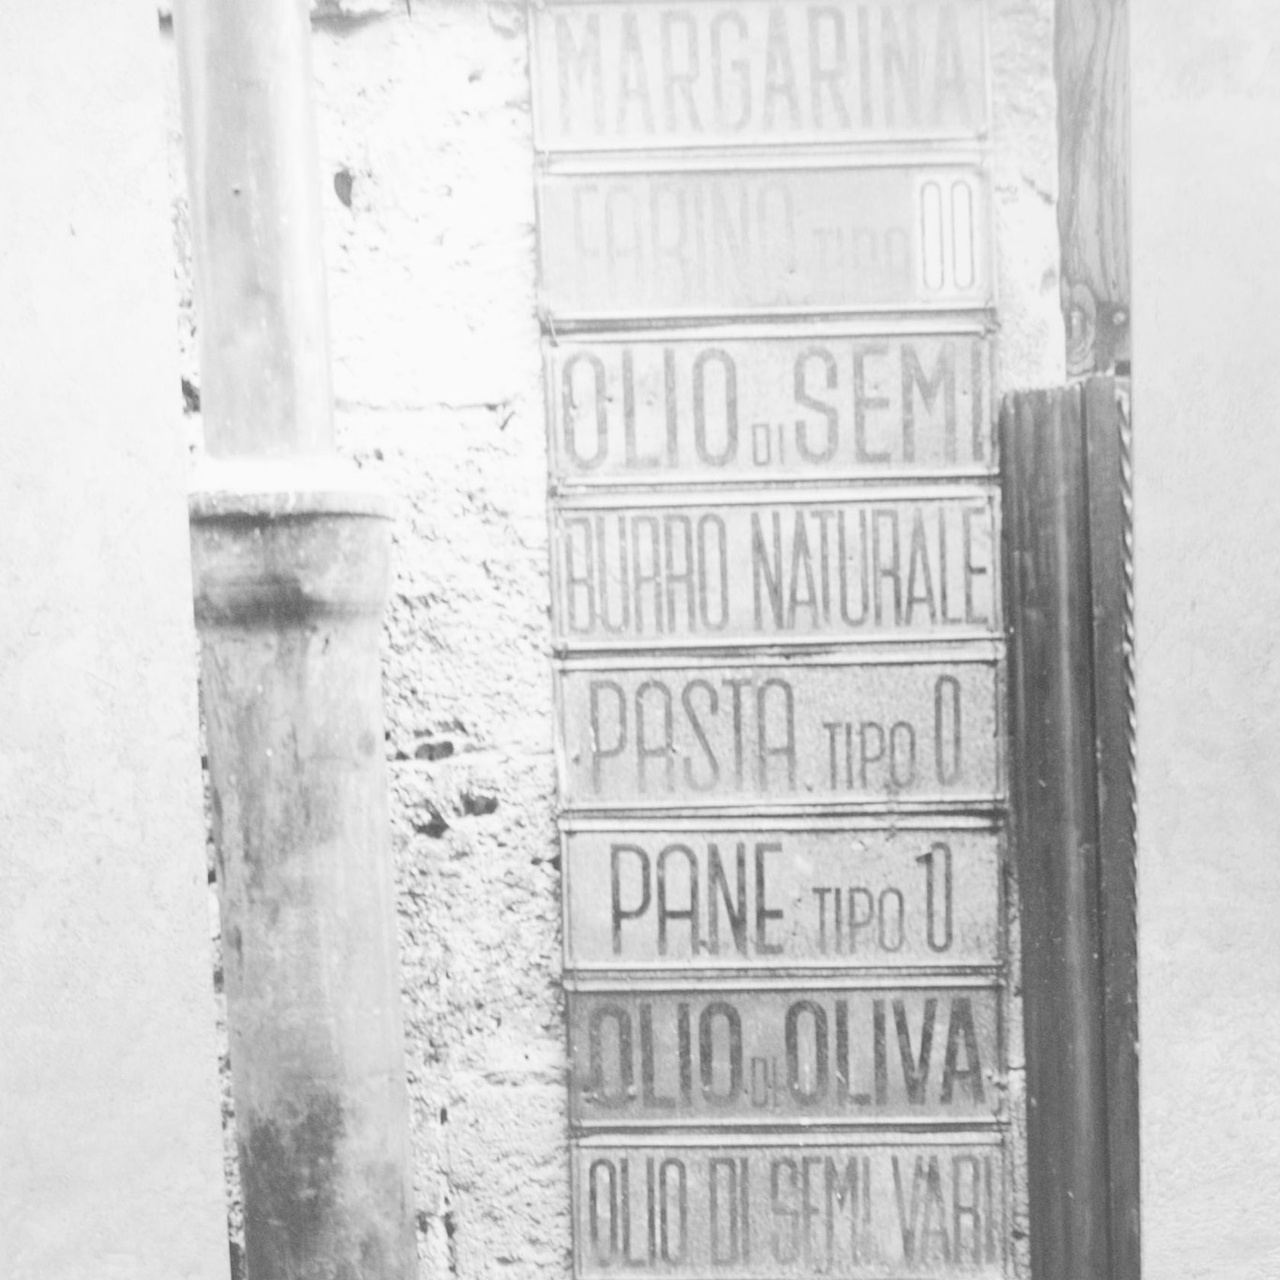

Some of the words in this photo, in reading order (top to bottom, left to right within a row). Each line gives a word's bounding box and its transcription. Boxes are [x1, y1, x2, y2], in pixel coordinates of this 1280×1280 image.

[556, 8, 968, 134] MARGARINA
[561, 345, 738, 470] OLIO
[751, 423, 784, 466] DI
[793, 342, 985, 465] SEMI
[564, 513, 729, 635] BURRO
[750, 508, 988, 631] NATURALE
[590, 677, 796, 793] PASTA
[823, 722, 916, 789] TIPO
[610, 843, 784, 956] PANE
[812, 887, 904, 954] TIPO
[588, 1003, 742, 1108] OLIO
[785, 999, 985, 1105] OLIVA
[589, 1157, 687, 1268] OLIO
[709, 1157, 750, 1266] DI
[770, 1156, 870, 1266] SEMI
